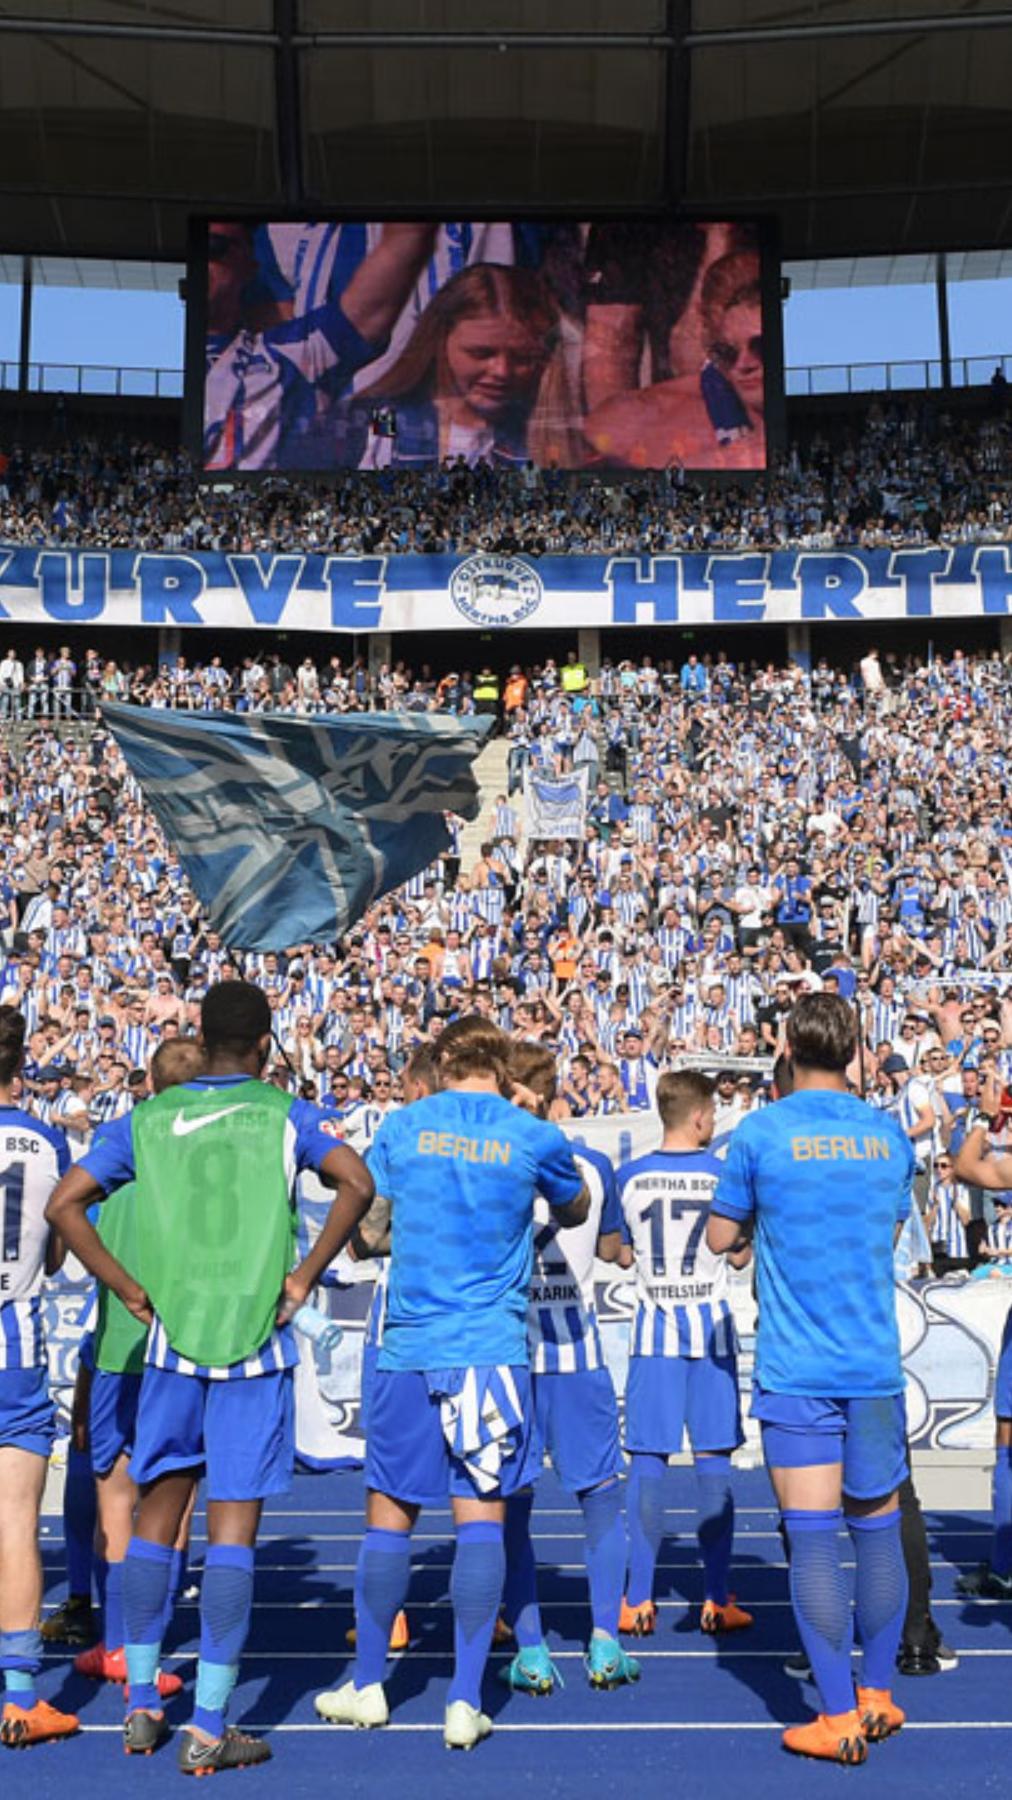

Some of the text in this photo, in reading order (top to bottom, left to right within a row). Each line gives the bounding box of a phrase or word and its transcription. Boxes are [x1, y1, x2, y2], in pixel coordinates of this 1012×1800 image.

[0, 549, 388, 628] URVE
[6, 1136, 39, 1154] BSC
[417, 1130, 511, 1165] BERLIN
[791, 1136, 890, 1161] BERLIN
[635, 1178, 687, 1190] HERTHA
[639, 1198, 712, 1277] 17
[530, 1285, 578, 1302] KARIK
